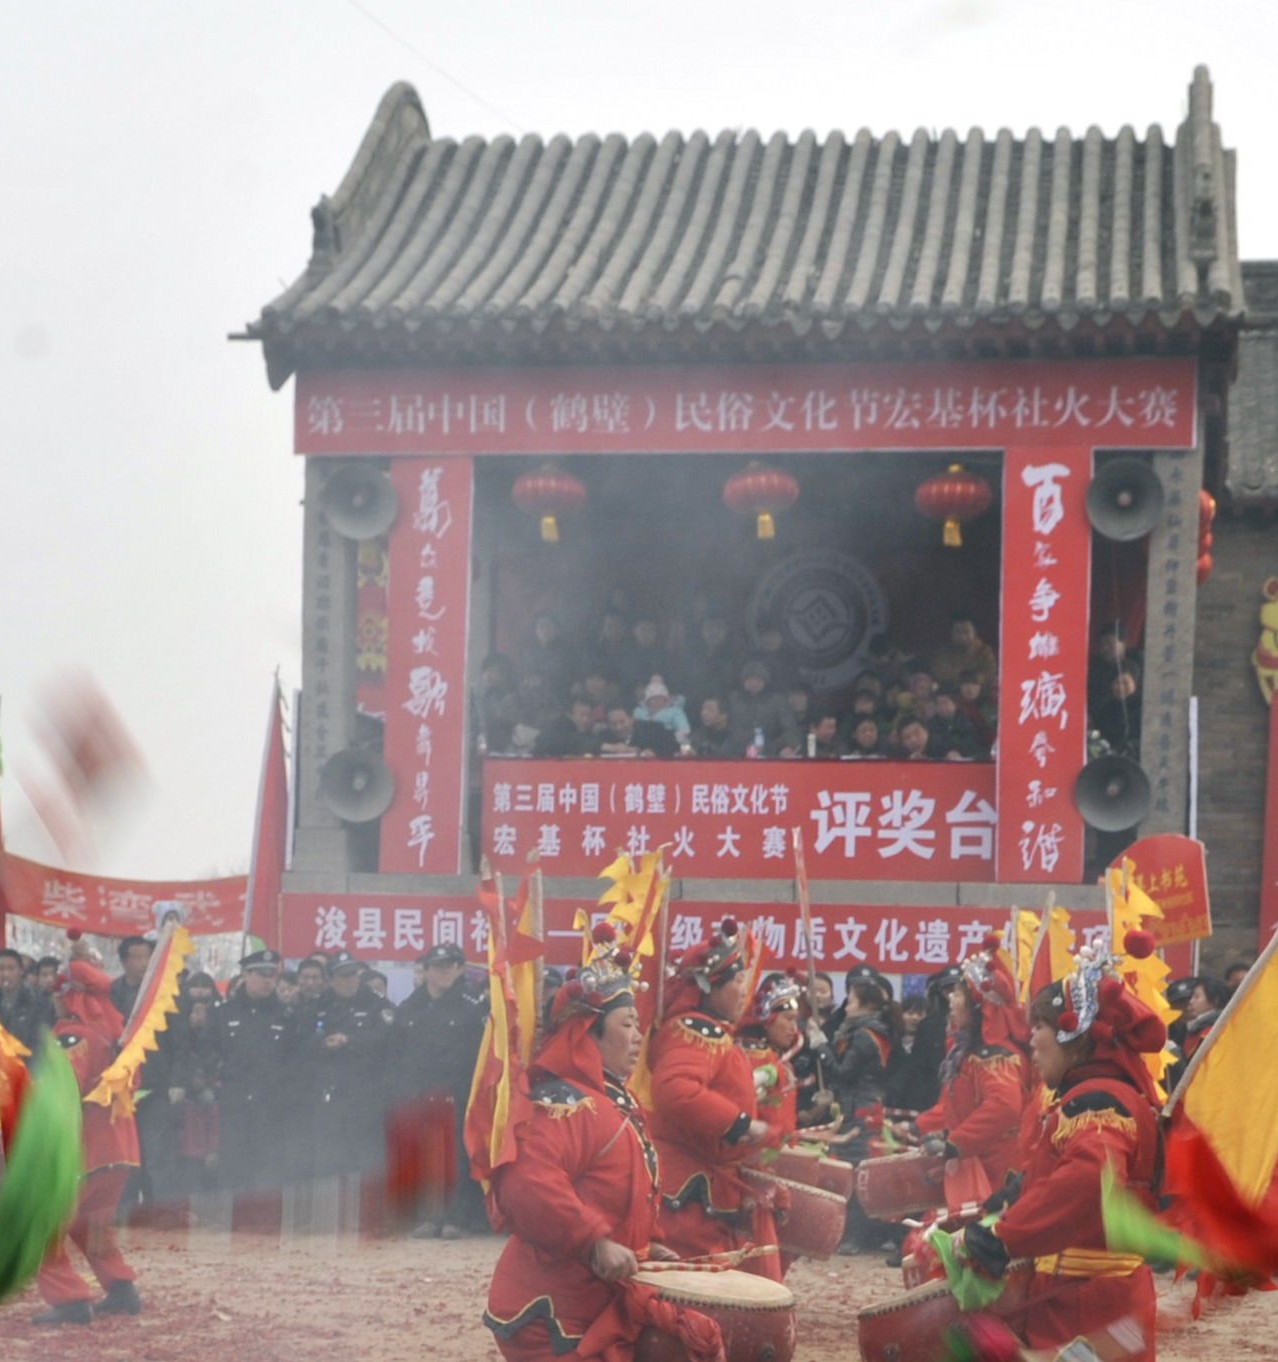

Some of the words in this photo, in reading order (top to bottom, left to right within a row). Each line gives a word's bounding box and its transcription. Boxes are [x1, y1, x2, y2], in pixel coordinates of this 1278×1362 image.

[493, 823, 787, 860] 宏基杯社火大赛
[809, 789, 997, 861] 评奖台
